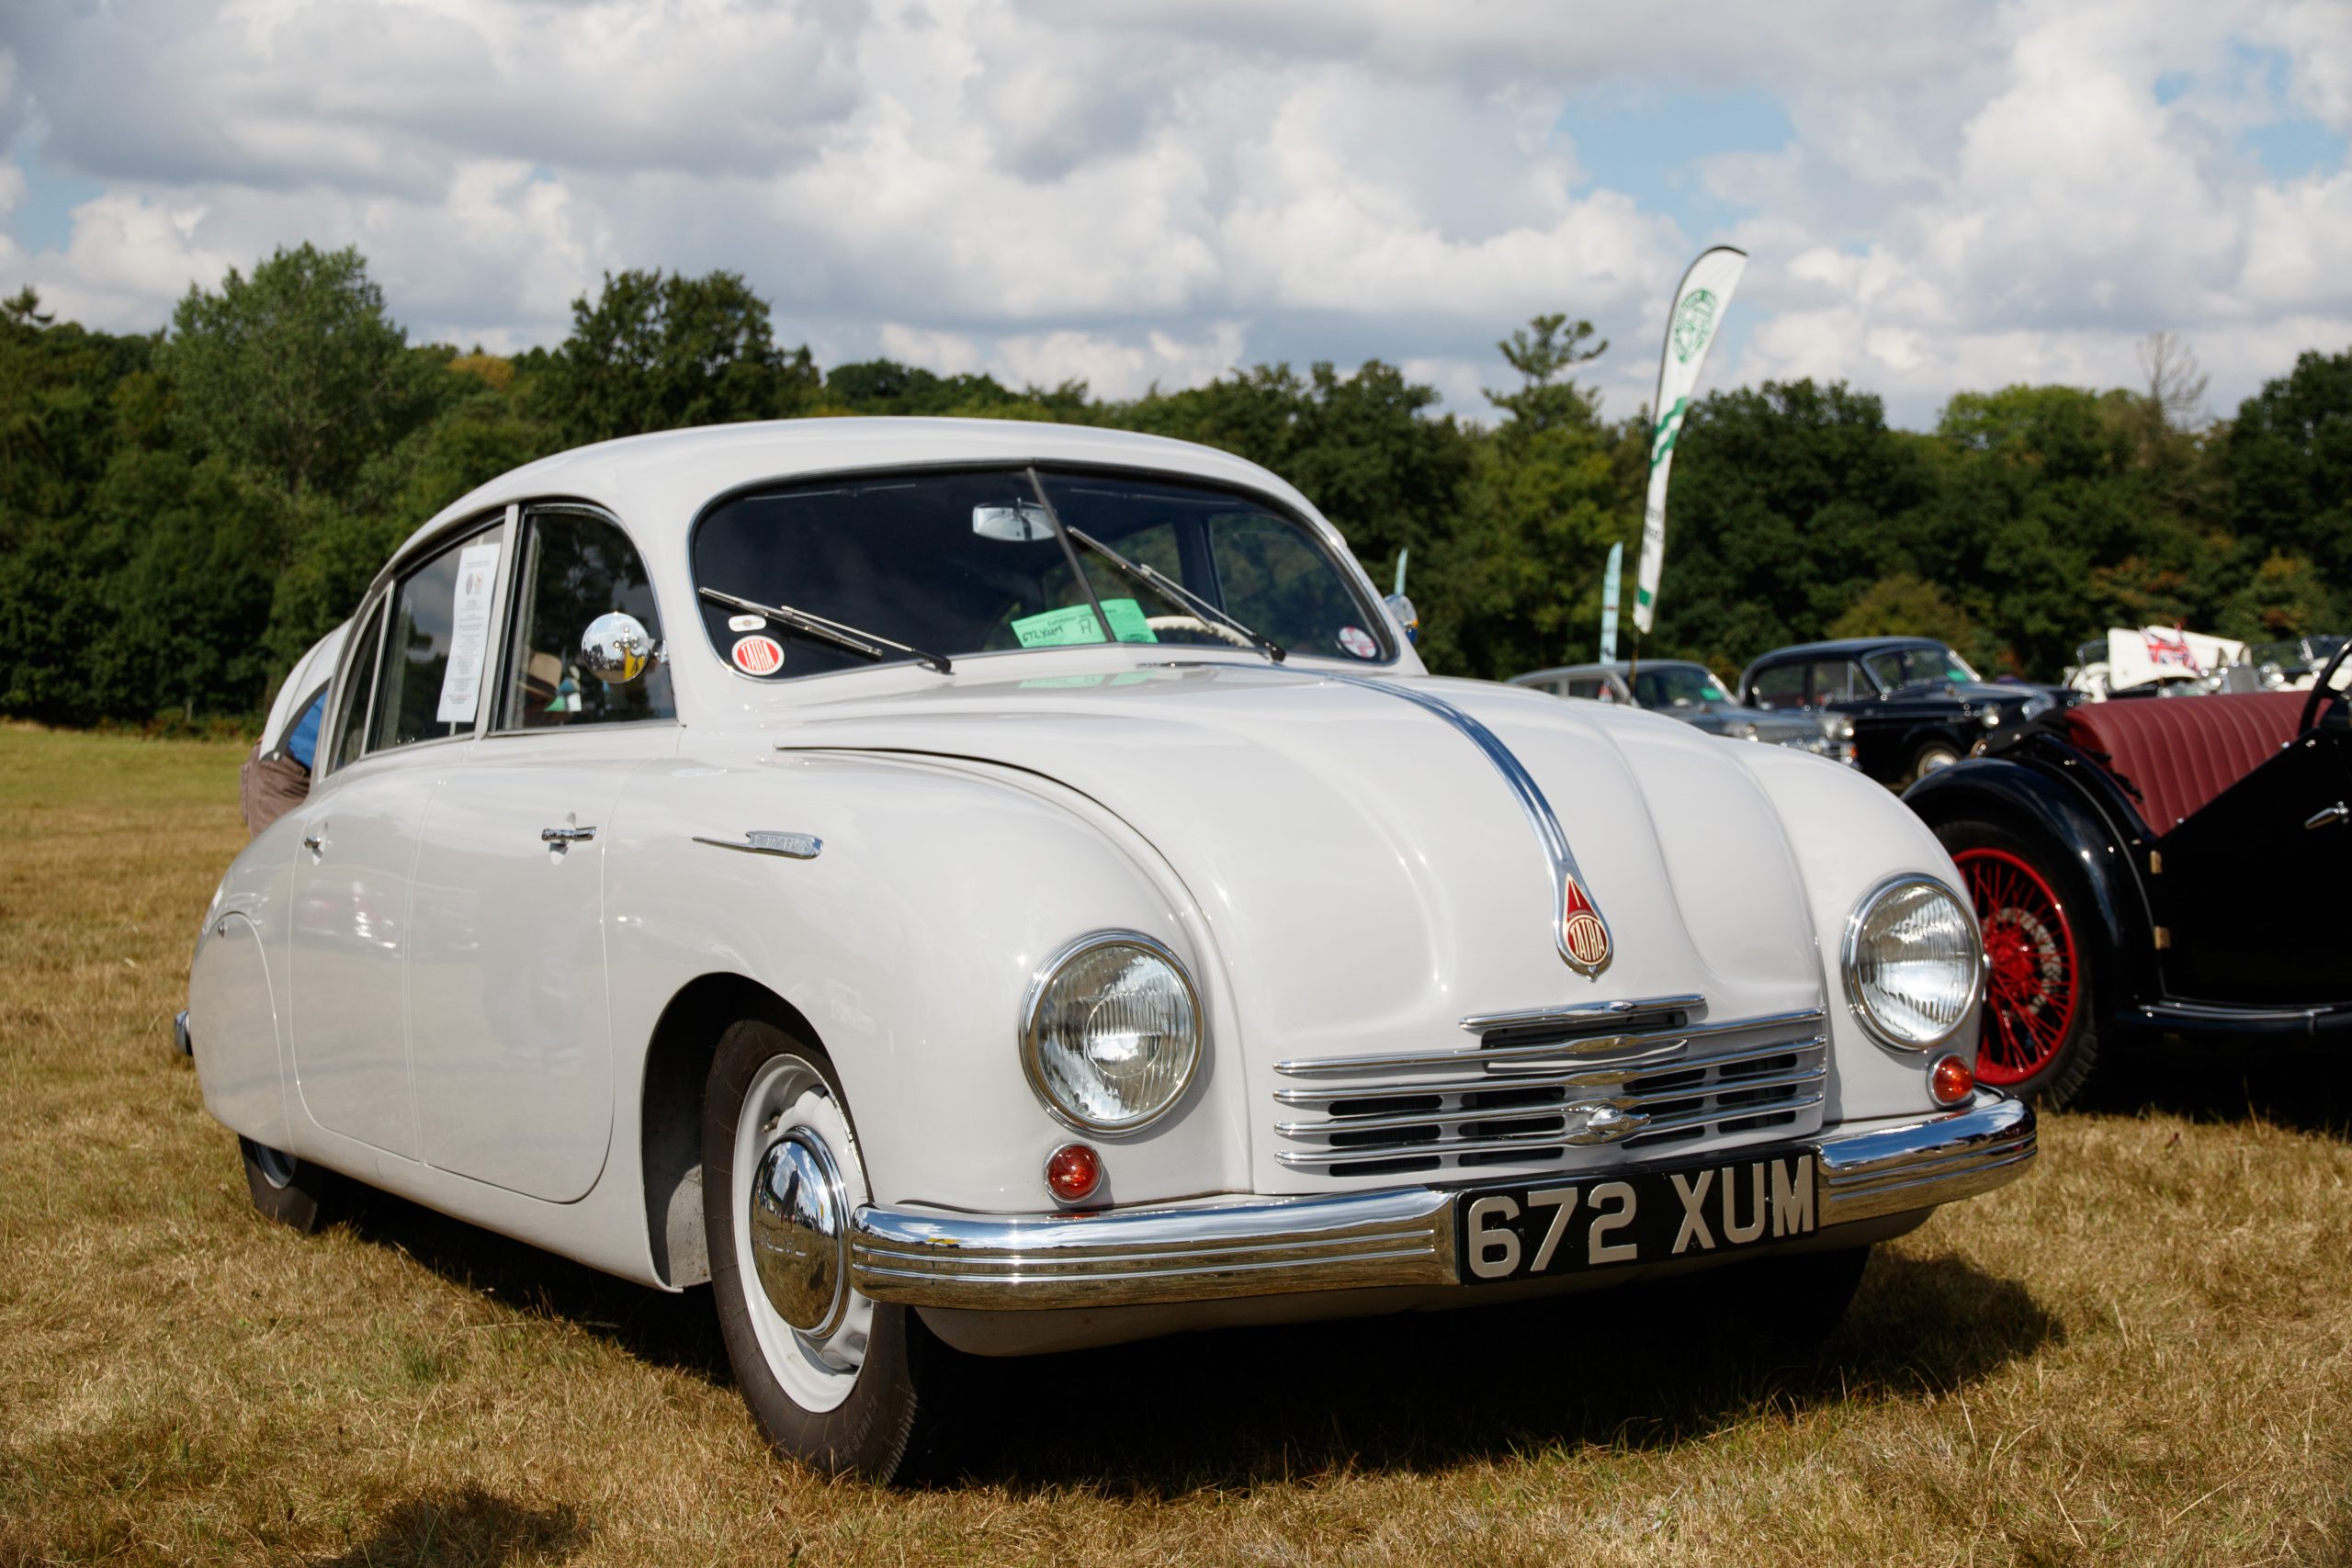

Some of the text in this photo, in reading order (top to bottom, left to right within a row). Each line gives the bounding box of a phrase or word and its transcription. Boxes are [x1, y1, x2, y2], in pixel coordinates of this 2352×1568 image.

[741, 639, 775, 671] TATRA
[1569, 919, 1605, 961] TATRA
[1468, 1155, 1814, 1278] 672 XUM
